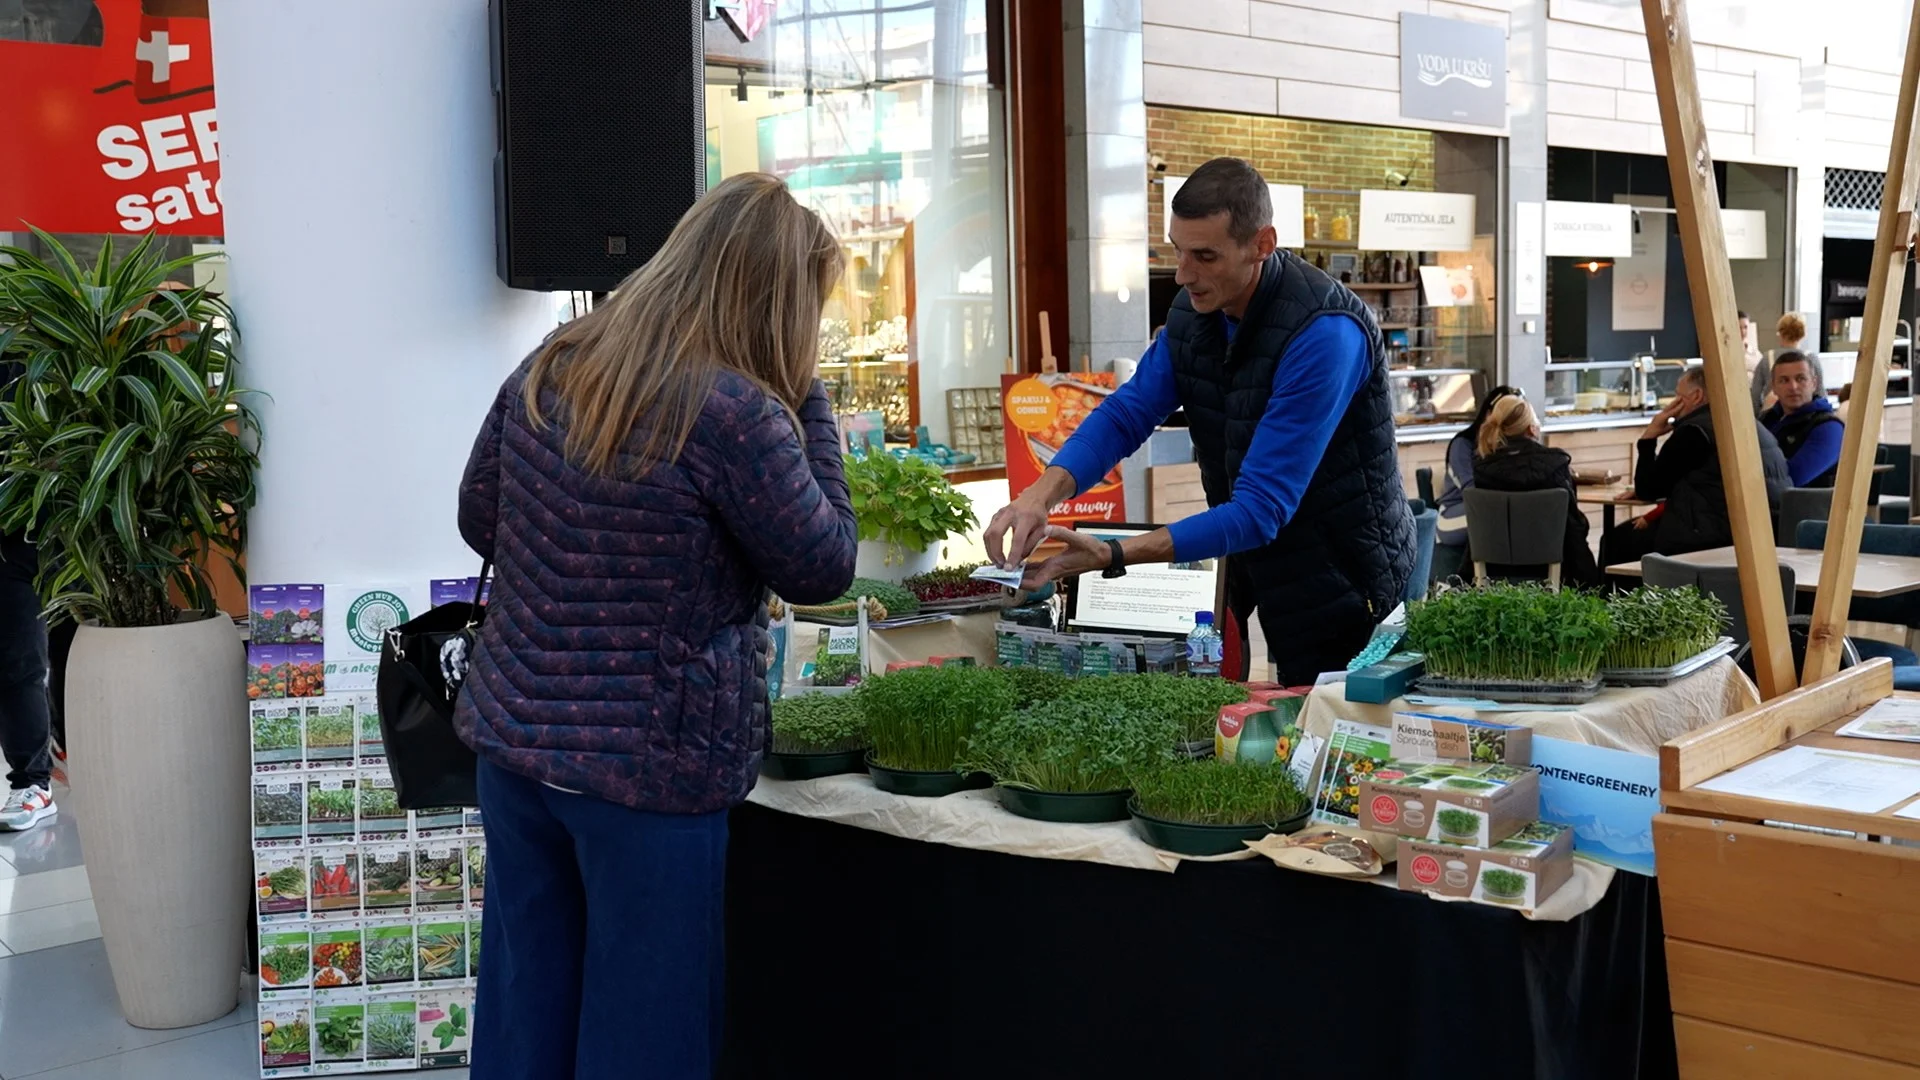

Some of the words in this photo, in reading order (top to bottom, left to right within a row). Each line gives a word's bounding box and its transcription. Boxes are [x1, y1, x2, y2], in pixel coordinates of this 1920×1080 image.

[1417, 53, 1450, 73] VODA
[115, 171, 223, 232] sat
[1074, 501, 1116, 520] away
[351, 593, 374, 614] GREEN
[374, 593, 393, 603] HUB
[1397, 723, 1466, 744] Kiemschaaltje
[1530, 764, 1657, 798] ONTENEGREENERY
